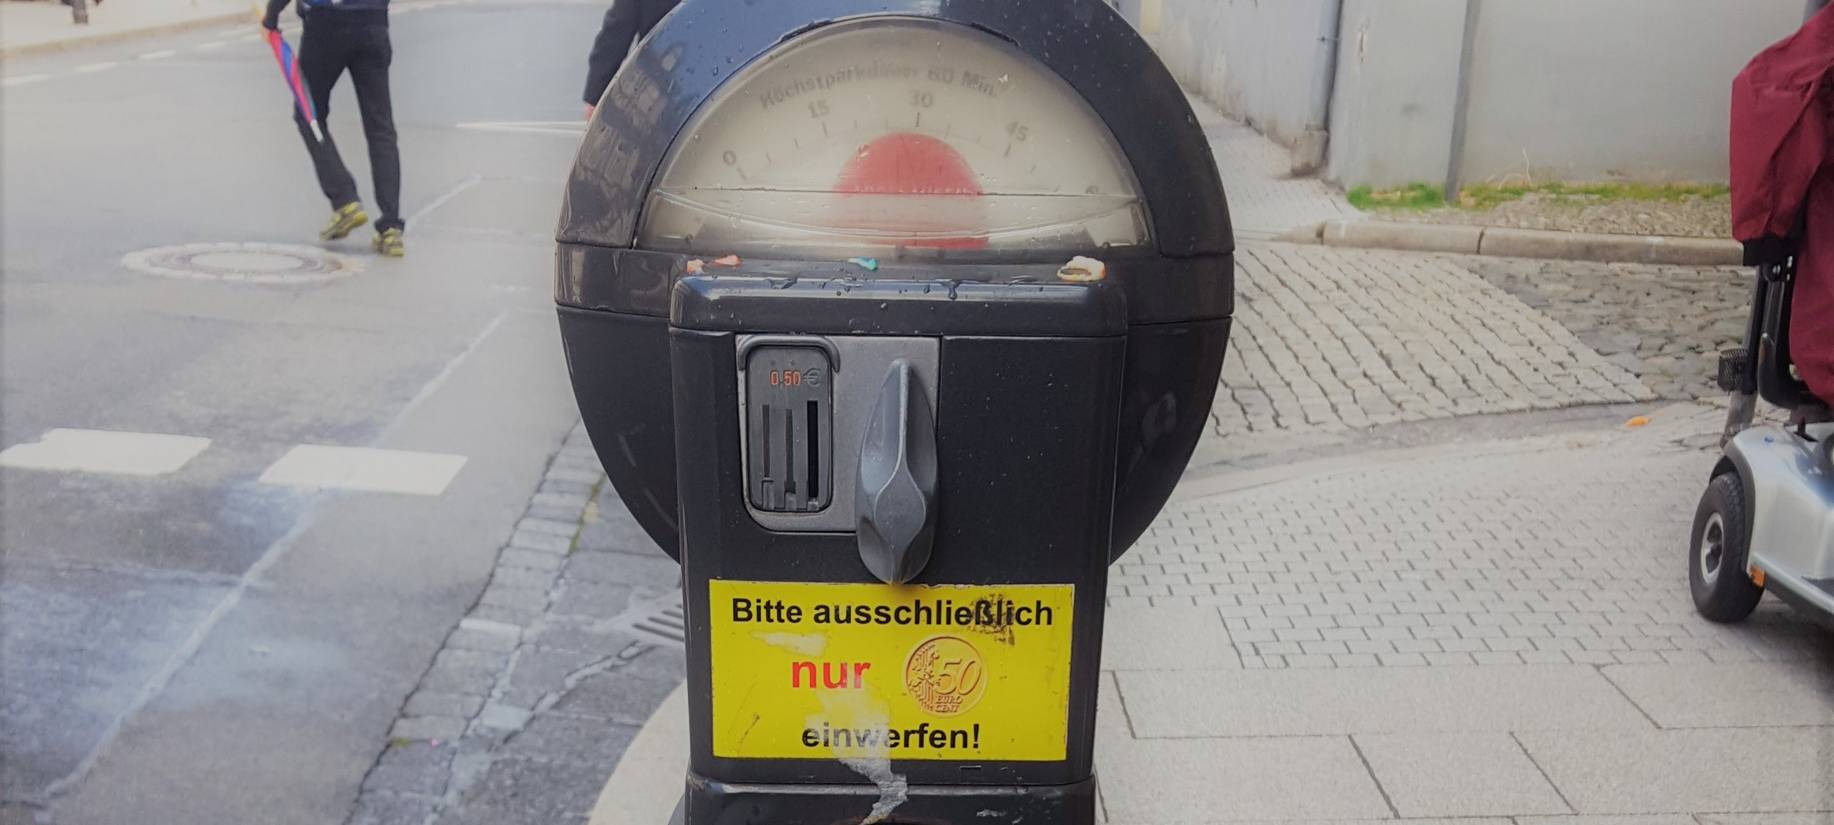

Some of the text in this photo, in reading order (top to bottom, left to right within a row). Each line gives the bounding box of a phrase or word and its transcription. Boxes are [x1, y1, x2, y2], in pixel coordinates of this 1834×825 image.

[759, 65, 918, 110] Höchstparkder
[723, 90, 1029, 167] 0 15 30 45
[732, 598, 1053, 626] Bitte ausschließlich
[791, 660, 871, 690] nur
[934, 658, 982, 696] 50
[935, 695, 963, 705] EURO
[935, 704, 960, 713] CENT
[802, 722, 980, 749] einwerfen!
